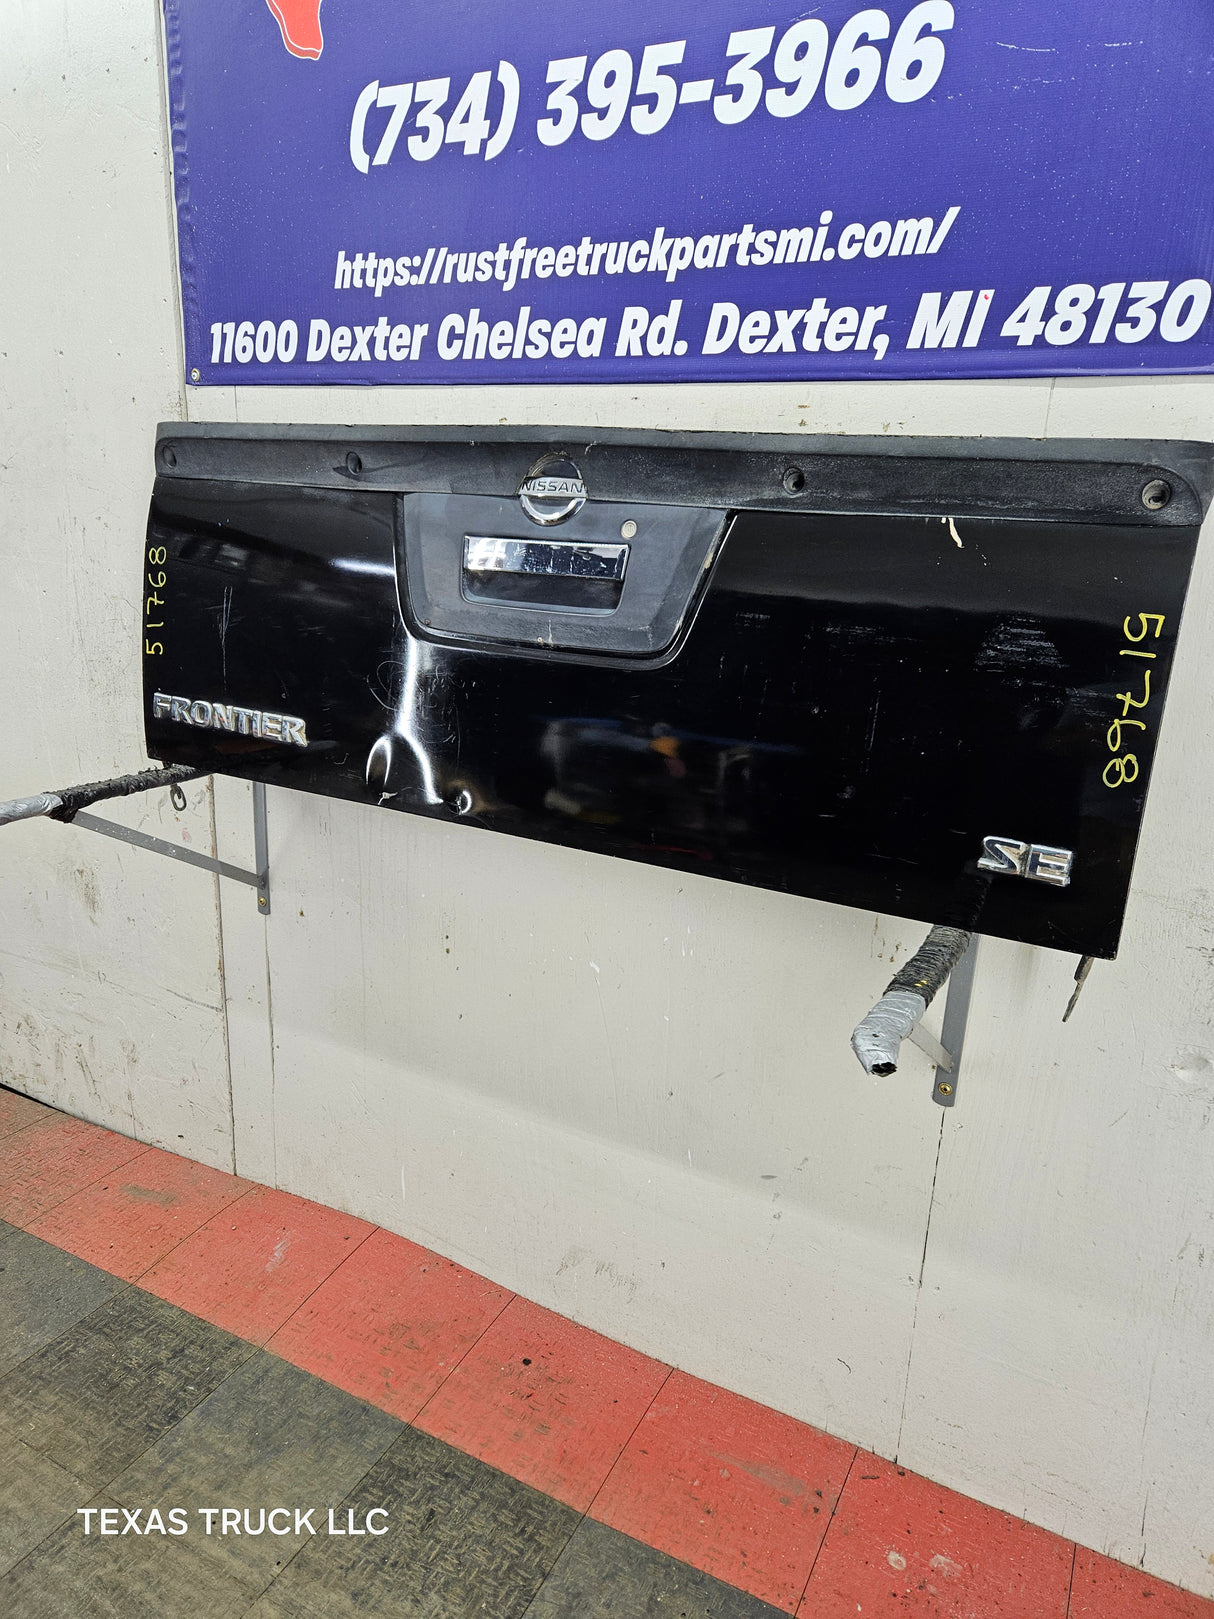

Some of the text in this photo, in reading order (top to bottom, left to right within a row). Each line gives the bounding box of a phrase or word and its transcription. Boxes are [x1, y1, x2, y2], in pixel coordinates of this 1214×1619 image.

[349, 0, 955, 174] (734) 395-3966
[334, 206, 961, 297] https://rustfreetruckpartsmi.com/
[209, 278, 1213, 364] 11600 Dexter Chelsea Rd. Dexter, MI 48130
[521, 479, 587, 494] NISSAN
[145, 546, 167, 656] 51768
[152, 691, 309, 748] FRONTIER
[1102, 612, 1166, 788] 51768
[977, 835, 1074, 887] SE
